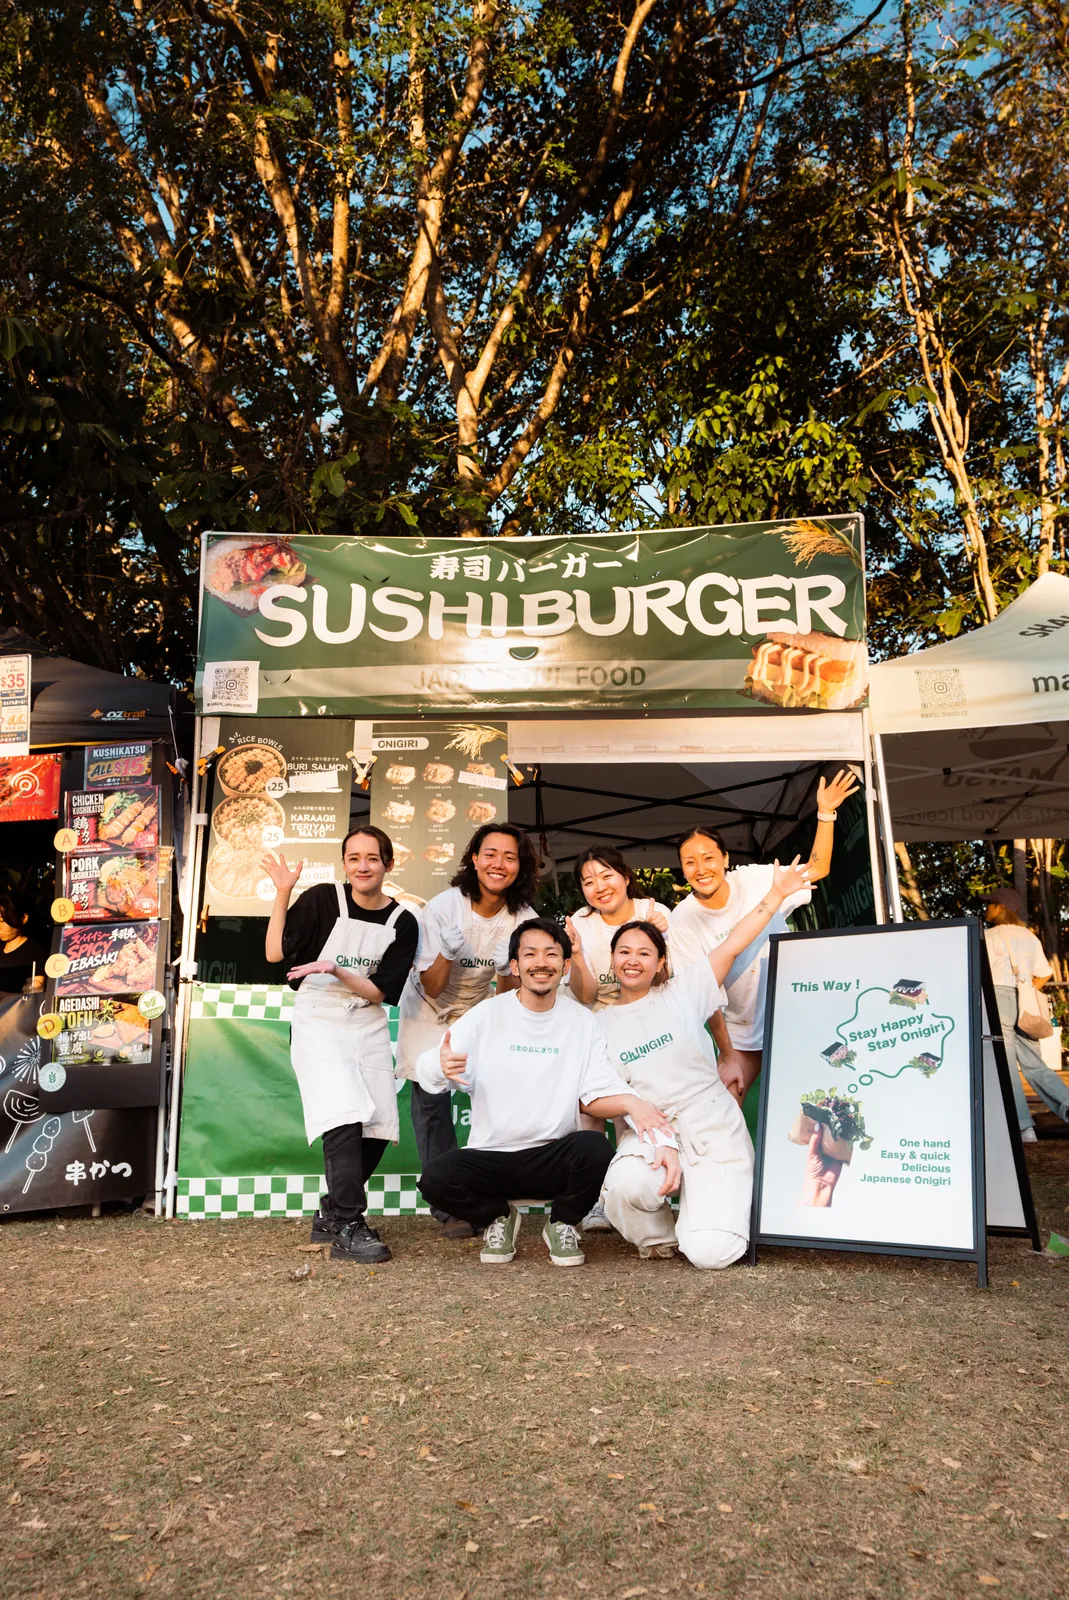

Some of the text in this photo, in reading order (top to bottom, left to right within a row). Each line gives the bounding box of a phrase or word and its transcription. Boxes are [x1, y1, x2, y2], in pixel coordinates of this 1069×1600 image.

[430, 552, 623, 583] 寿司バーガー
[0, 673, 25, 689] $35
[576, 666, 646, 687] FOOD
[237, 735, 284, 751] RICE BOWLS
[377, 739, 418, 748] ONIGIRI
[93, 744, 146, 758] KUSHIKATSU
[90, 757, 145, 778] ALL $15
[311, 763, 349, 772] SALMON
[267, 782, 284, 791] $25
[72, 793, 105, 807] CHICKEN
[72, 805, 105, 815] KUSHIKATSU
[290, 813, 336, 822] KARAAGE
[291, 823, 335, 832] TERIYAKI
[62, 834, 73, 846] A
[71, 856, 99, 872] PORK
[70, 869, 101, 880] KUSHIKATSU
[58, 904, 68, 917] B
[67, 940, 113, 960] SPICY
[53, 960, 62, 972] C
[66, 951, 119, 975] TEBASAKI
[791, 982, 819, 993] This
[823, 980, 852, 992] Way
[59, 996, 100, 1013] AGEDASHI
[43, 1019, 55, 1034] D
[60, 1010, 93, 1029] TOFU
[849, 1013, 924, 1043] Stay Happy
[867, 1020, 946, 1052] Stay Onigiri
[58, 1041, 82, 1056] 豆腐
[509, 1043, 560, 1055] 日本のおにぎり屋
[899, 1139, 951, 1148] One hand
[881, 1150, 951, 1162] Easy & quick
[65, 1159, 132, 1186] 串かつ
[901, 1163, 951, 1173] Delicious
[860, 1174, 951, 1187] Japanese Onigiri
